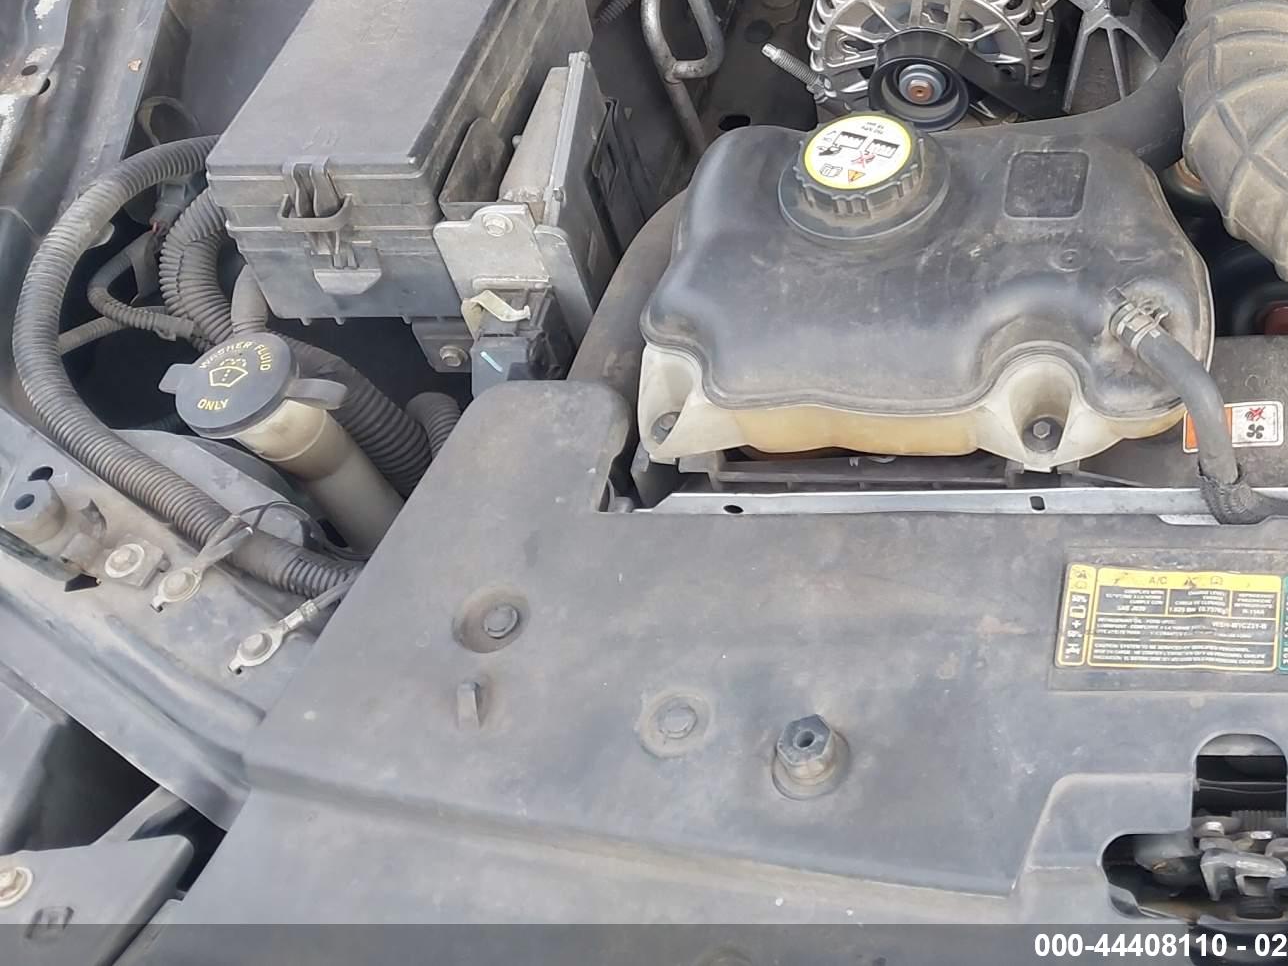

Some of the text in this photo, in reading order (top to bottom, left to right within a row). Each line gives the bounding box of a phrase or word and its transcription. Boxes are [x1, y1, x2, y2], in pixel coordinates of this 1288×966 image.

[199, 341, 273, 371] WASHER FLUID
[197, 398, 229, 411] ONLY
